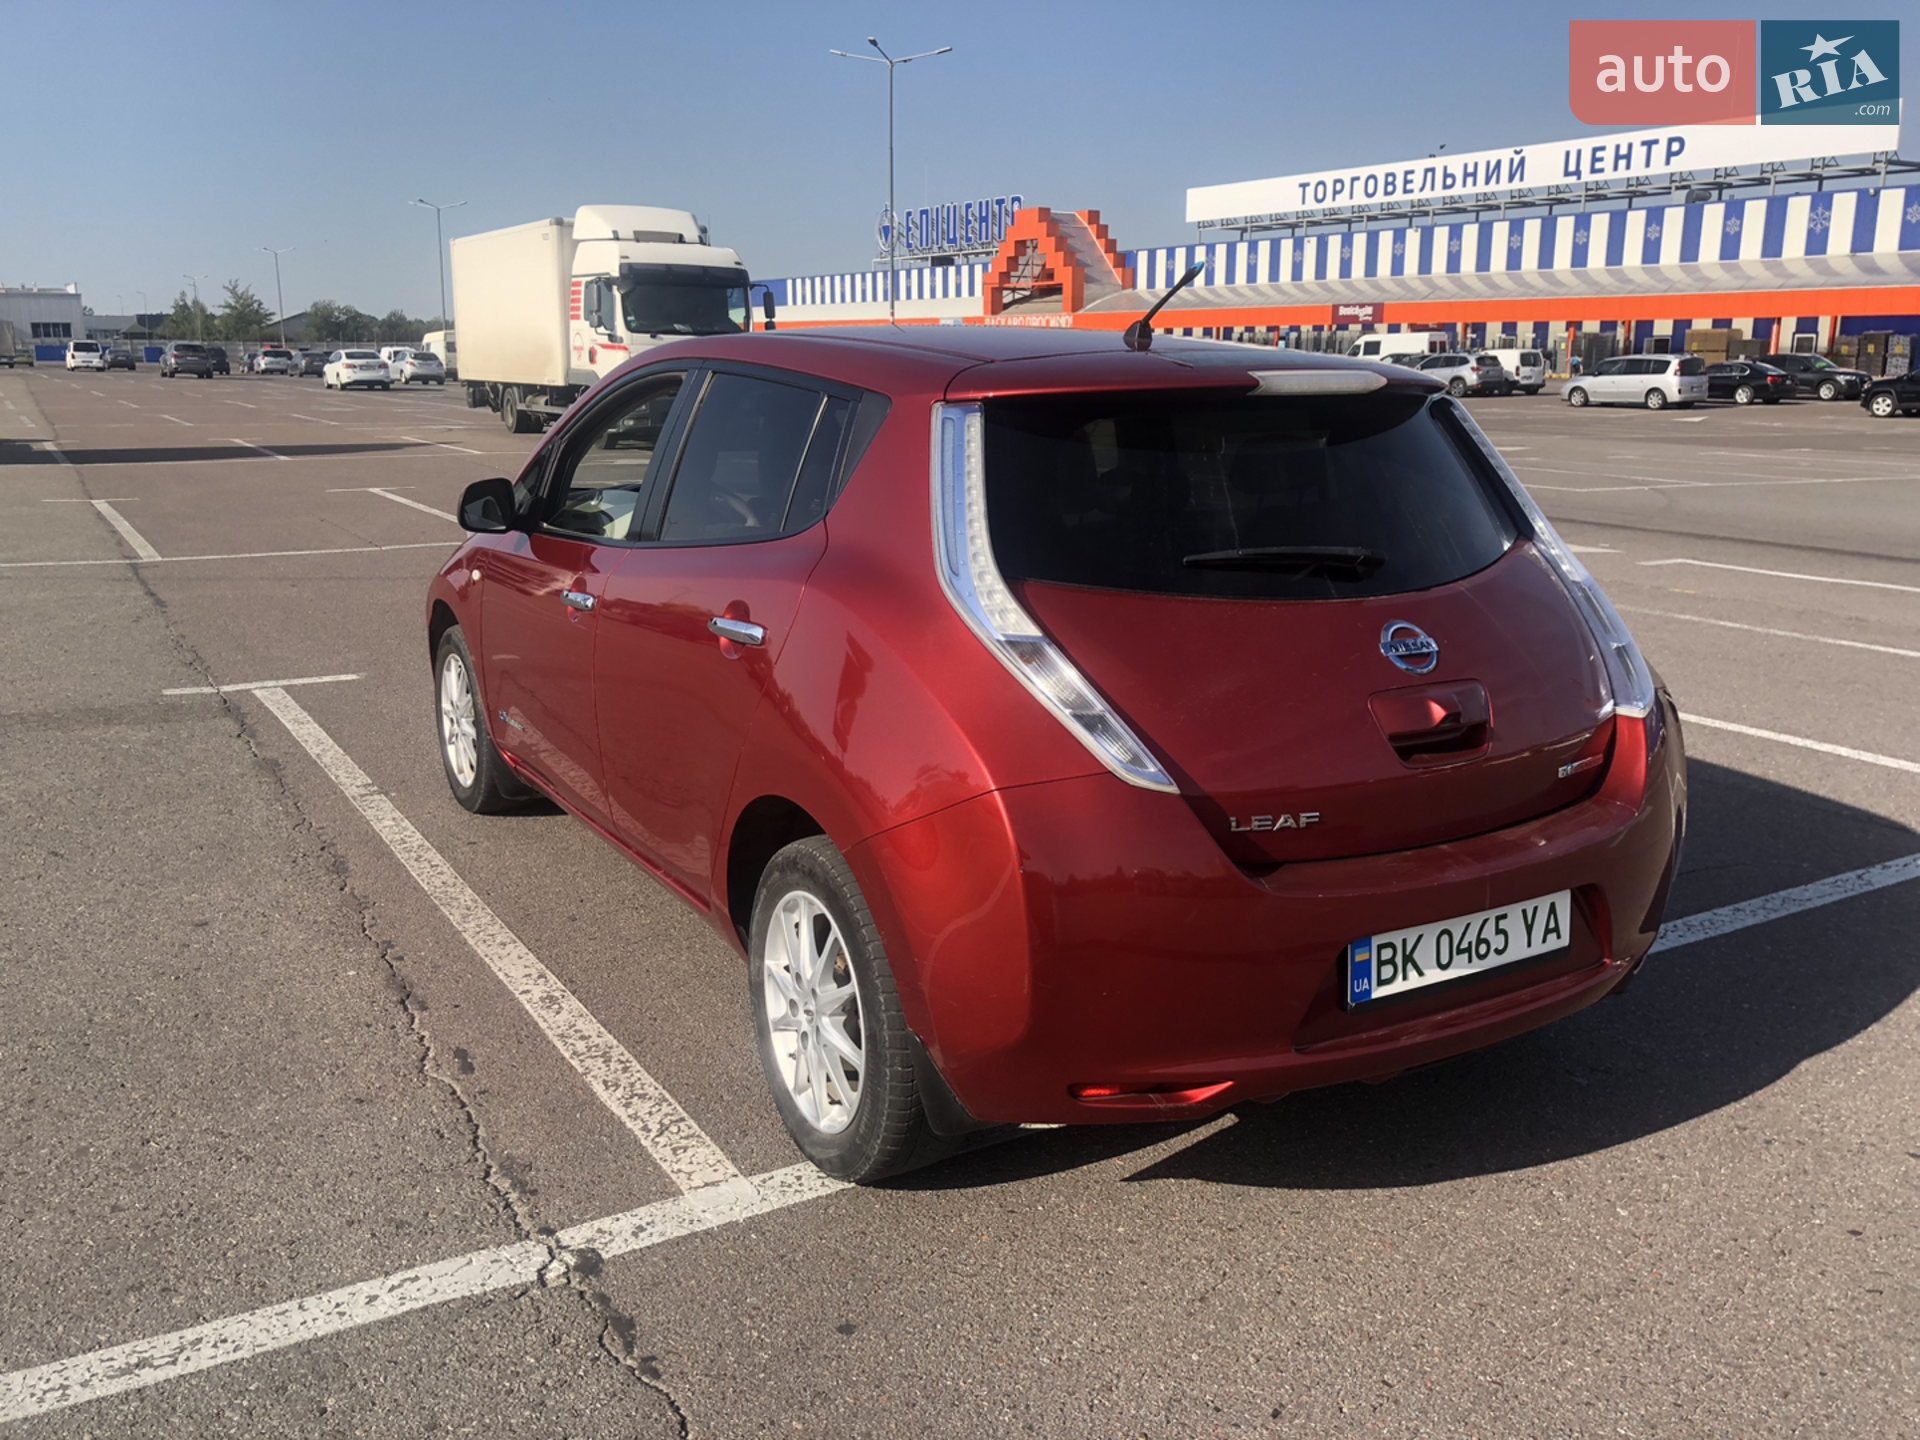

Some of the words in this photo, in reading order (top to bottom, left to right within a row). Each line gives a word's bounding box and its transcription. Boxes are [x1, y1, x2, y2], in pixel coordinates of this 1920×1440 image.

[1298, 149, 1527, 206] ТОРГОВЕЛЬНИЙ
[1563, 136, 1686, 181] ЦЕНТР
[1389, 639, 1435, 653] NISSAN
[1229, 812, 1320, 831] LEAF
[1376, 933, 1425, 987] BK
[1435, 912, 1509, 971] 0465
[1521, 901, 1562, 948] YA
[1354, 977, 1370, 993] UA
